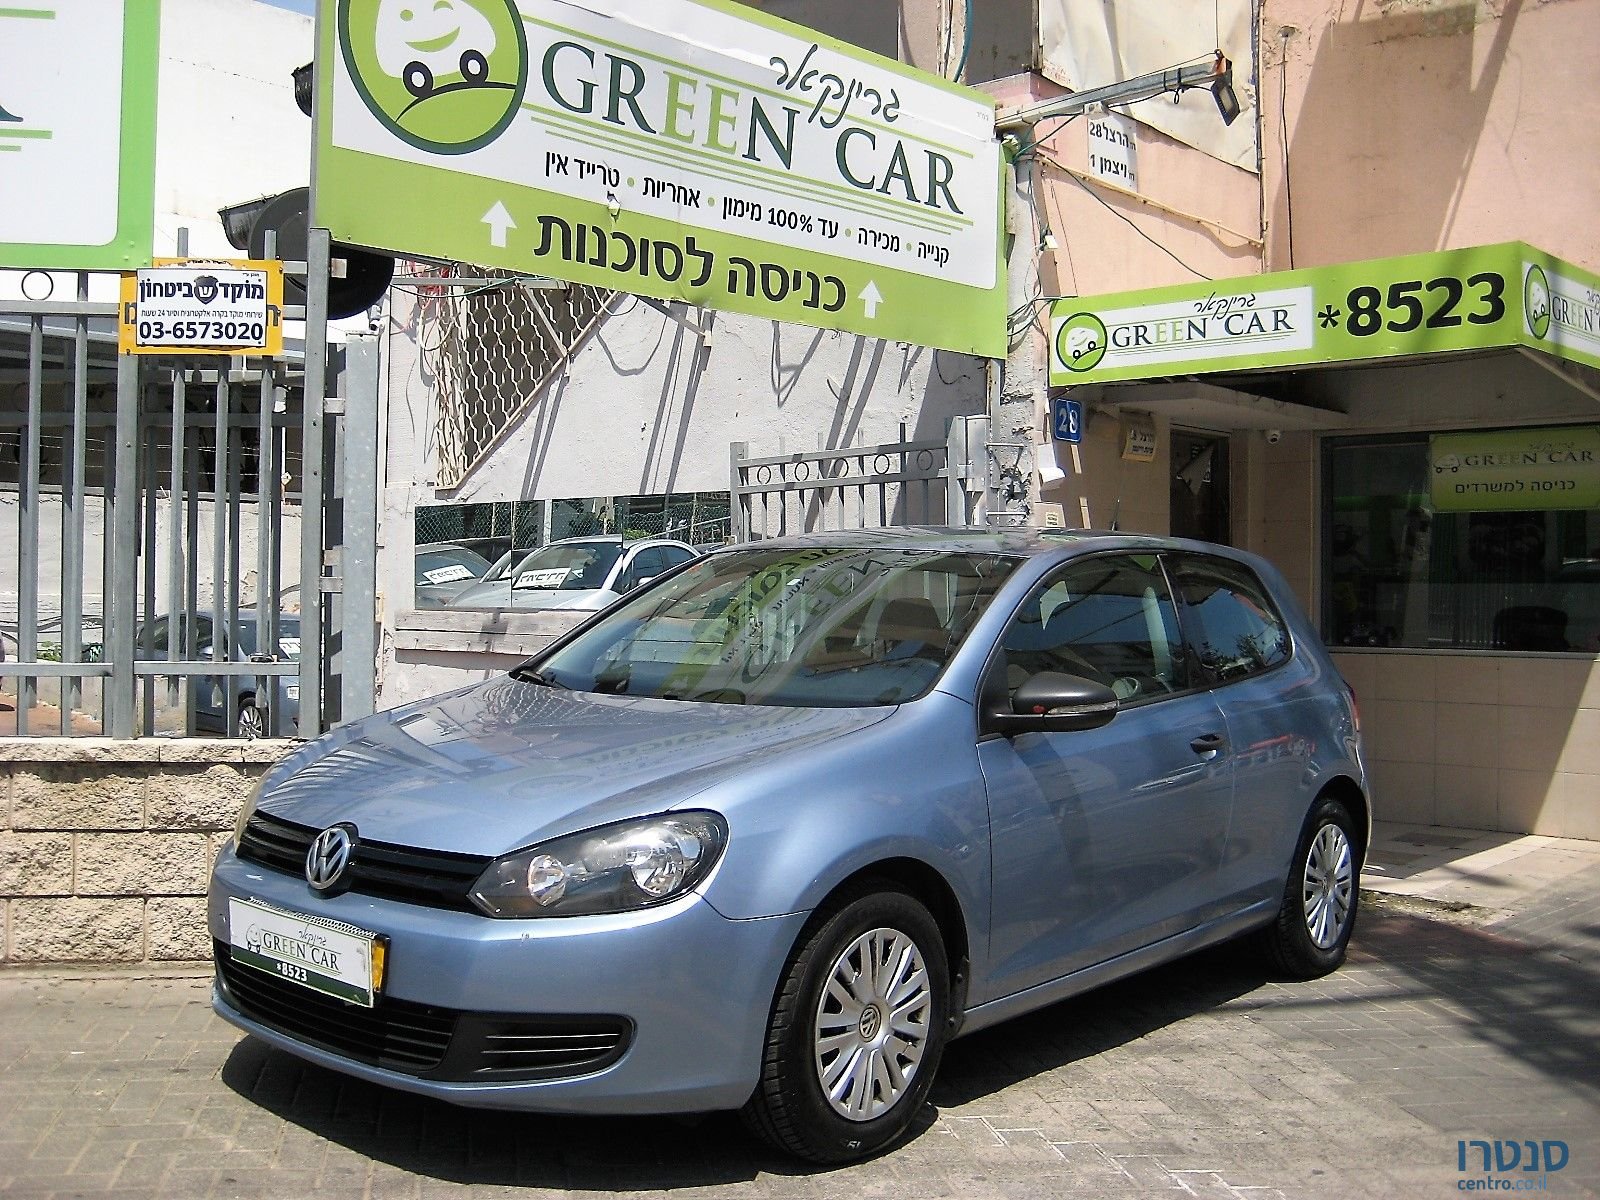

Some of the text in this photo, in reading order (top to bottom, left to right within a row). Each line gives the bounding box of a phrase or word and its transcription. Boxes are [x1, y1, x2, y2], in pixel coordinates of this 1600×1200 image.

[769, 44, 900, 129] גרינקאר
[542, 41, 964, 215] GREEN CAR
[1090, 154, 1096, 168] 1
[1099, 156, 1127, 178] ויצמן
[545, 151, 950, 268] קנייה מכירה עד 100% מימון אחריות טרייד אין
[533, 215, 847, 312] כניסה לסוכנות
[139, 280, 194, 303] ביטחון
[219, 282, 264, 304] מוקד
[1193, 291, 1256, 320] גרינקאר
[1552, 296, 1593, 332] GREEN
[139, 322, 264, 341] 03-6573020
[1112, 309, 1295, 348] GREEN CAR
[1058, 407, 1079, 434] 28
[1548, 450, 1593, 463] CAR
[1455, 480, 1576, 494] כניסה למשרדים
[263, 932, 340, 971] GREEN CAR
